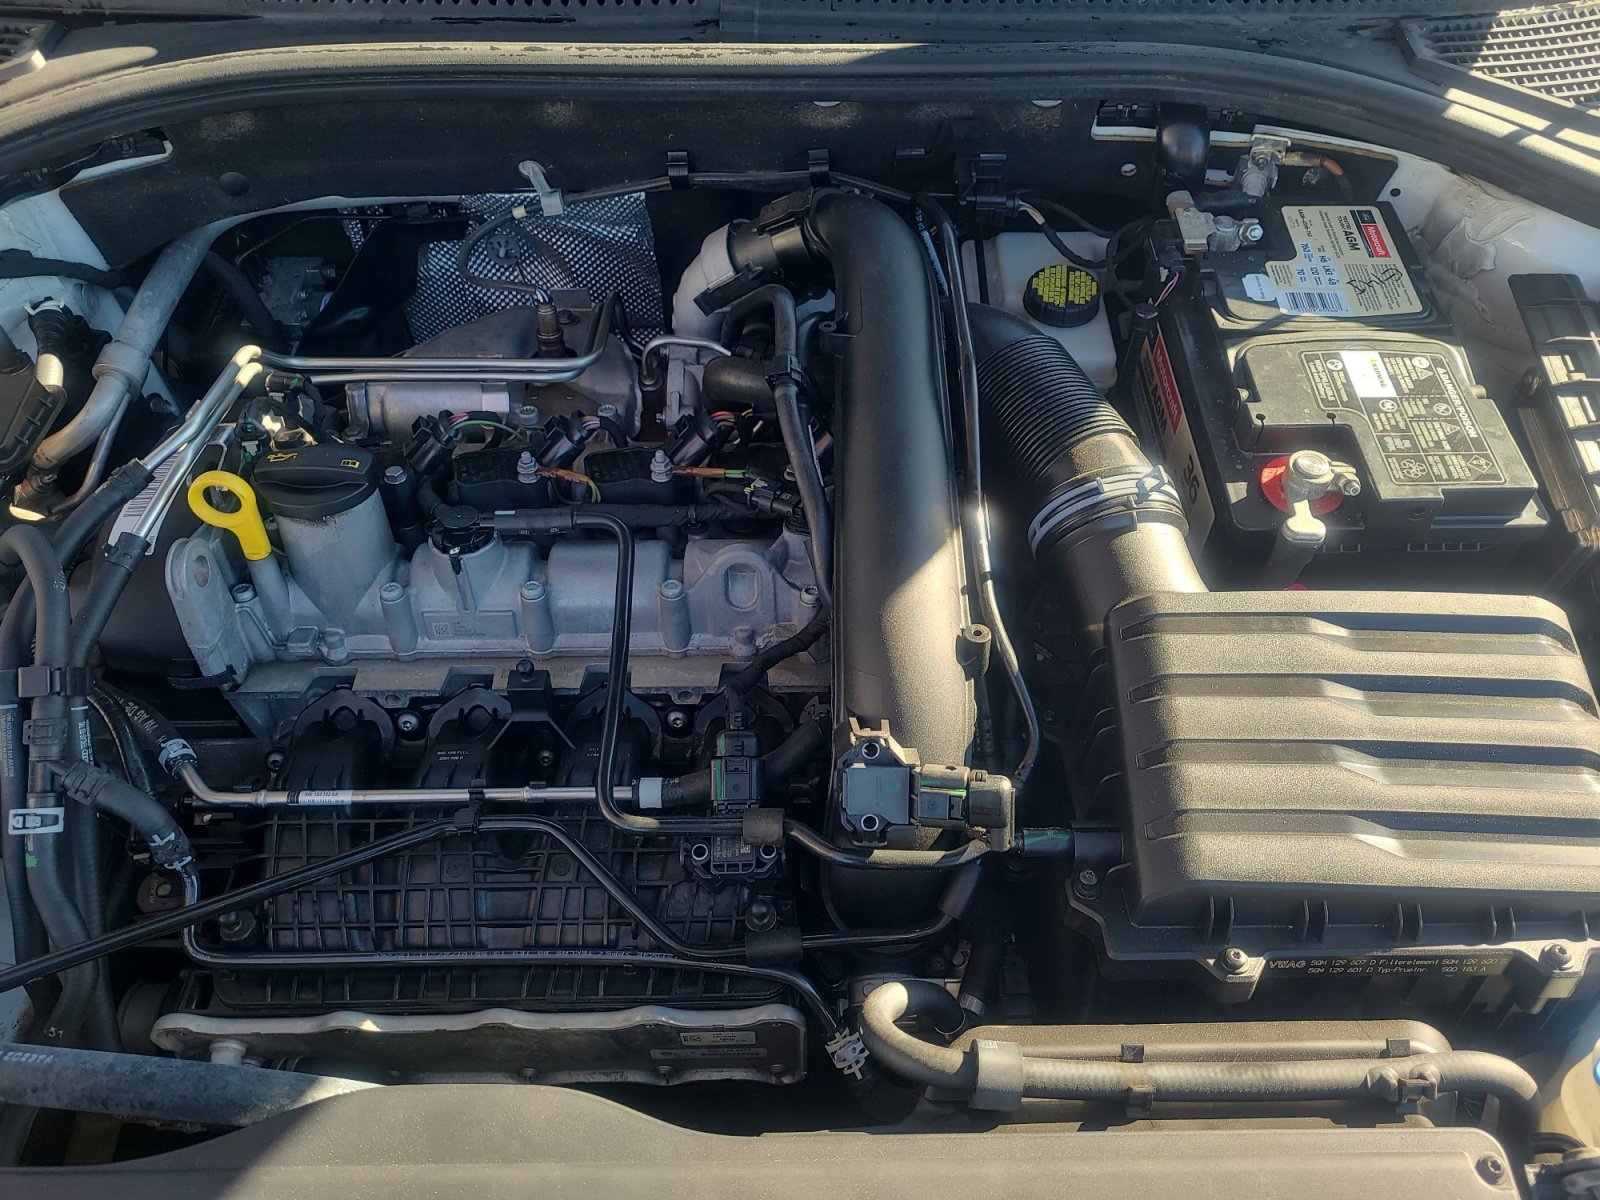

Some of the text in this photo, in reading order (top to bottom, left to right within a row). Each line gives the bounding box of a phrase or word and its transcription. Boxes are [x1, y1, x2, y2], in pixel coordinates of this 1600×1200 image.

[1343, 229, 1361, 251] AGM
[1367, 226, 1386, 256] Motorcraft
[1155, 348, 1178, 418] Motorcraft
[1440, 374, 1478, 437] DANGER/POISON
[1151, 384, 1167, 434] AGM
[1184, 454, 1200, 504] 36
[1379, 958, 1439, 966] Filterelement
